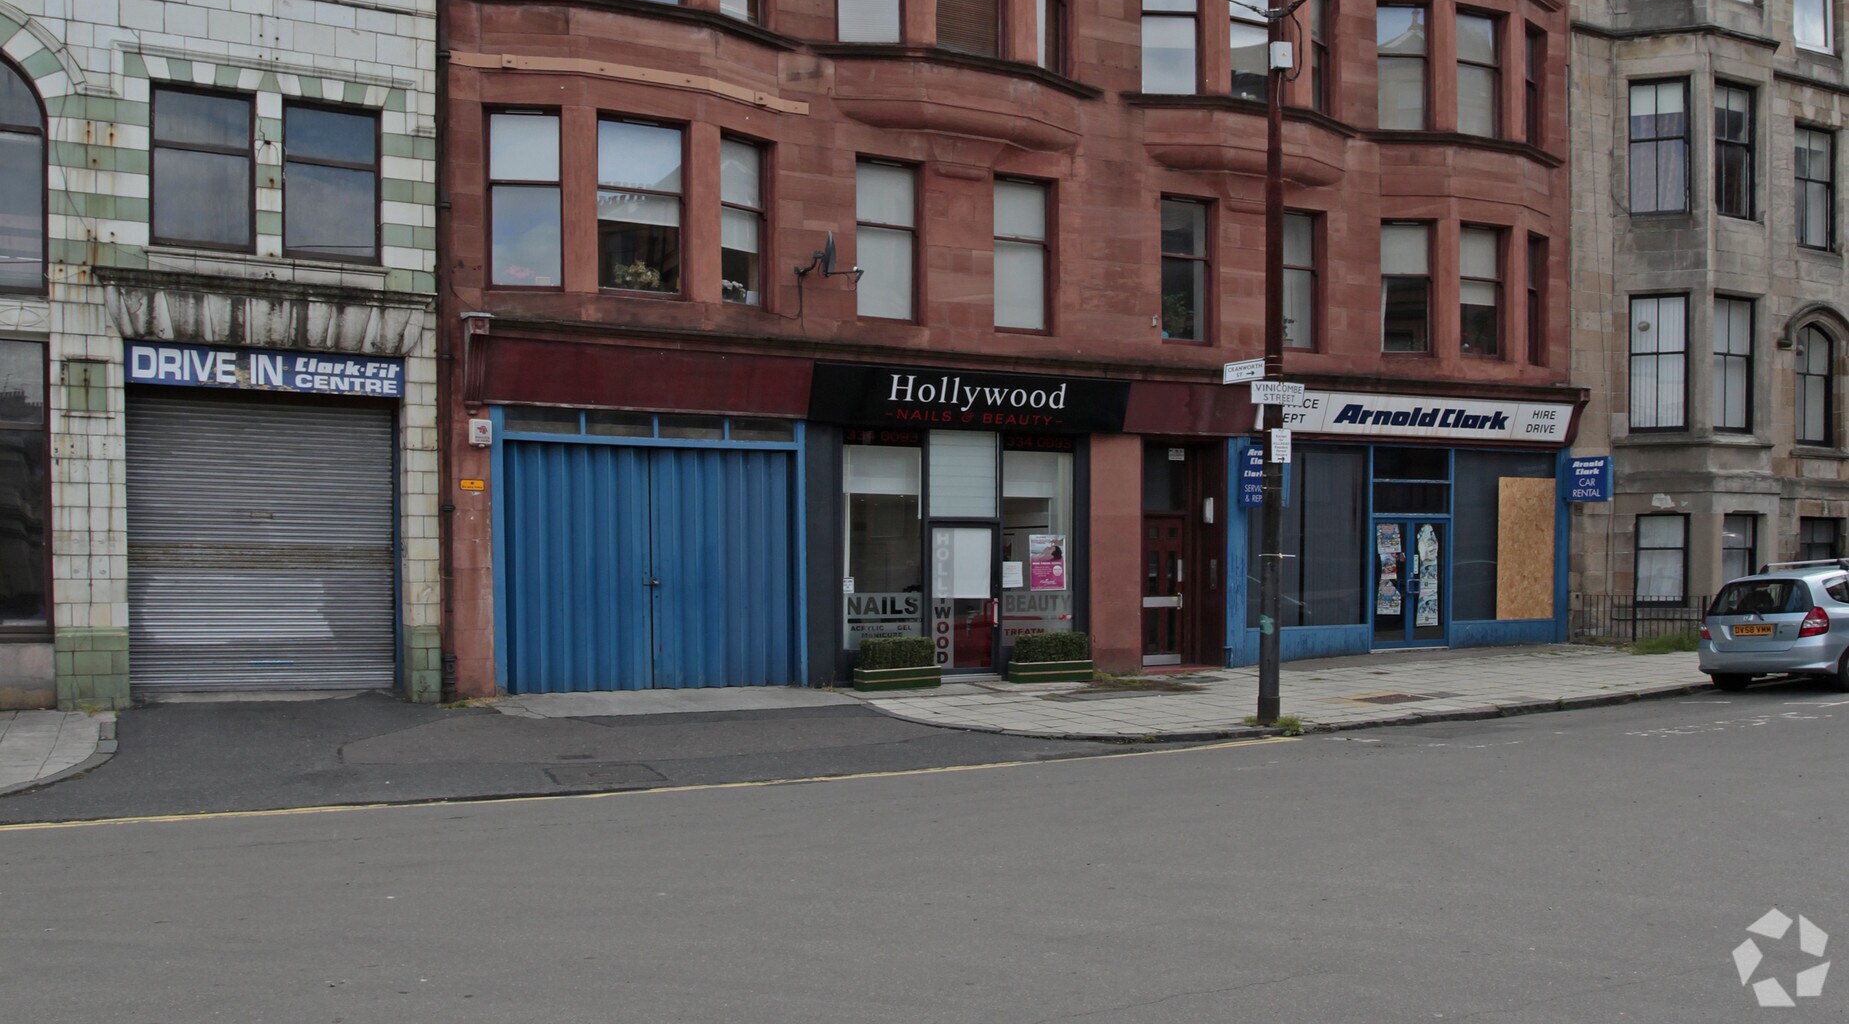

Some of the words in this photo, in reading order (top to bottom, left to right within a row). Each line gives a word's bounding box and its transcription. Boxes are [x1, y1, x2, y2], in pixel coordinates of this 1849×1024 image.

[131, 345, 237, 384] DRIVE
[250, 353, 283, 386] IN
[1227, 363, 1263, 373] CRANWORTH
[294, 374, 398, 394] CENTRE
[1255, 383, 1302, 395] VINICOMBE
[887, 374, 1067, 412] Hollywood
[1263, 393, 1295, 403] STREET
[1333, 403, 1441, 428] Arnold
[1437, 408, 1510, 430] Clark
[1532, 409, 1557, 420] HIRE
[1525, 423, 1556, 435] DRIVE
[1572, 460, 1604, 468] Arnold
[1578, 478, 1596, 487] CAR
[1572, 488, 1601, 498] RENTAL
[847, 596, 919, 615] NAILS
[1005, 595, 1072, 612] BEAUTY
